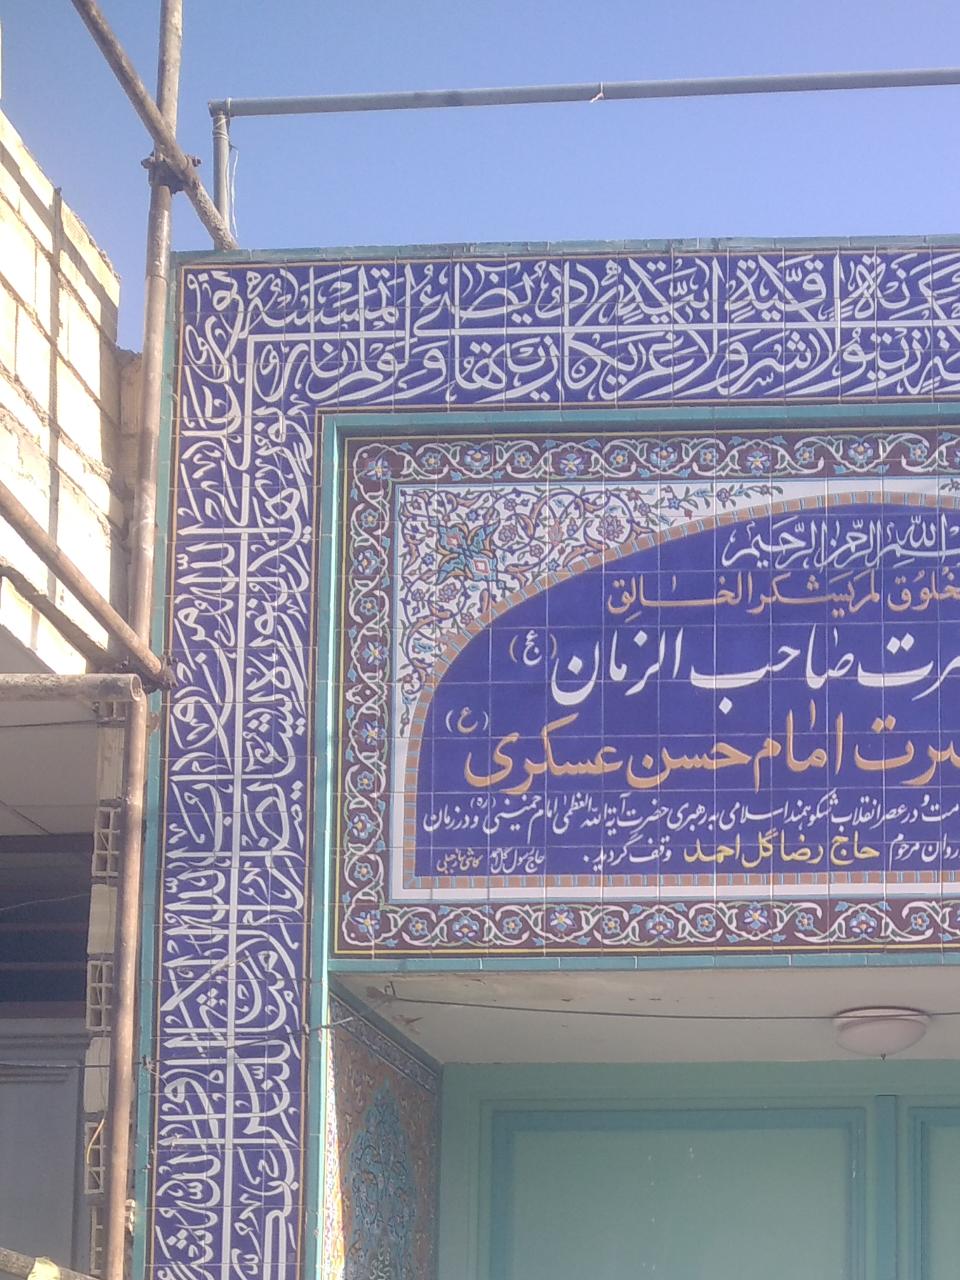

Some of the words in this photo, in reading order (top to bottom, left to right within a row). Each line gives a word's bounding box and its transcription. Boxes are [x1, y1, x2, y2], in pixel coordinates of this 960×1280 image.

[899, 513, 946, 561] الله
[607, 574, 754, 616] الخالق
[850, 567, 880, 612] لم
[550, 627, 684, 706] الزمان
[690, 623, 854, 715] صاحب
[463, 713, 623, 795] عسکری
[626, 737, 752, 788] حسن
[753, 700, 844, 793] امام
[684, 833, 741, 864] احمد
[741, 828, 779, 868] گل
[780, 829, 825, 864] رضا
[830, 830, 881, 866] حاج
